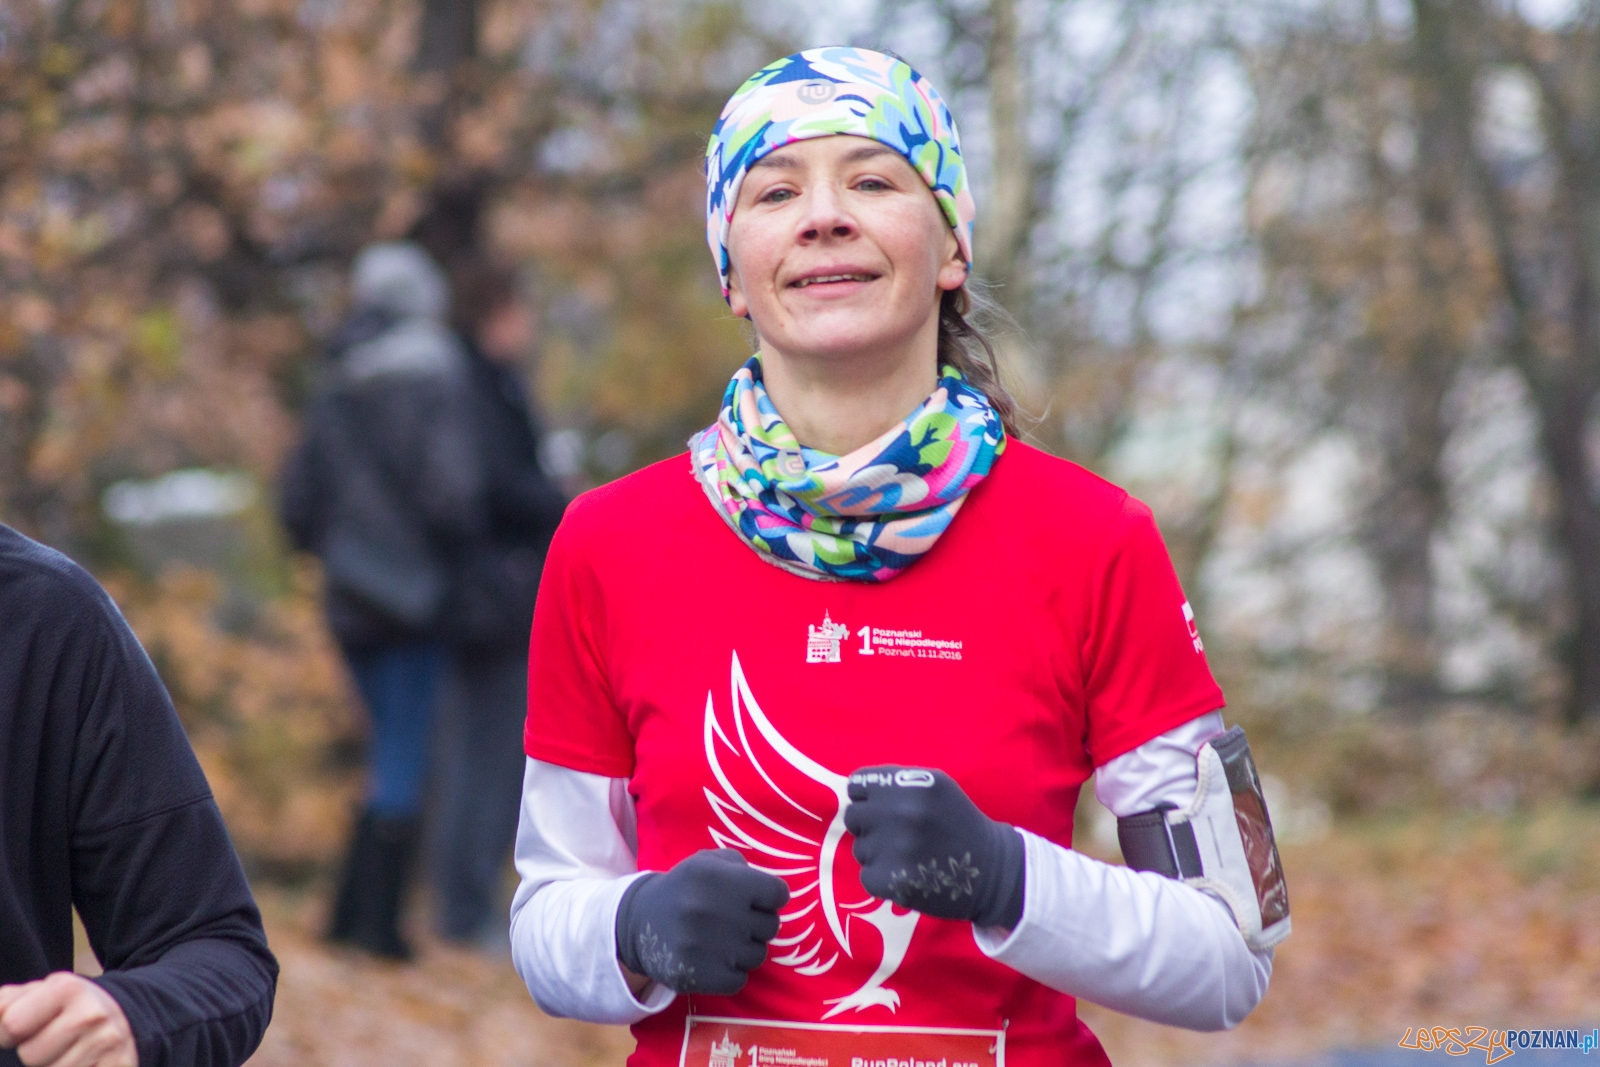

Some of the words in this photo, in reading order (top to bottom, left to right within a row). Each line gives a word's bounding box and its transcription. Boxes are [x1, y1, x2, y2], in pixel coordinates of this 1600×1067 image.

[872, 628, 922, 638] Poznański
[857, 625, 875, 655] 1
[872, 636, 894, 646] Bieg
[895, 638, 963, 649] Niepodległości
[917, 649, 962, 660] 11.11.2016
